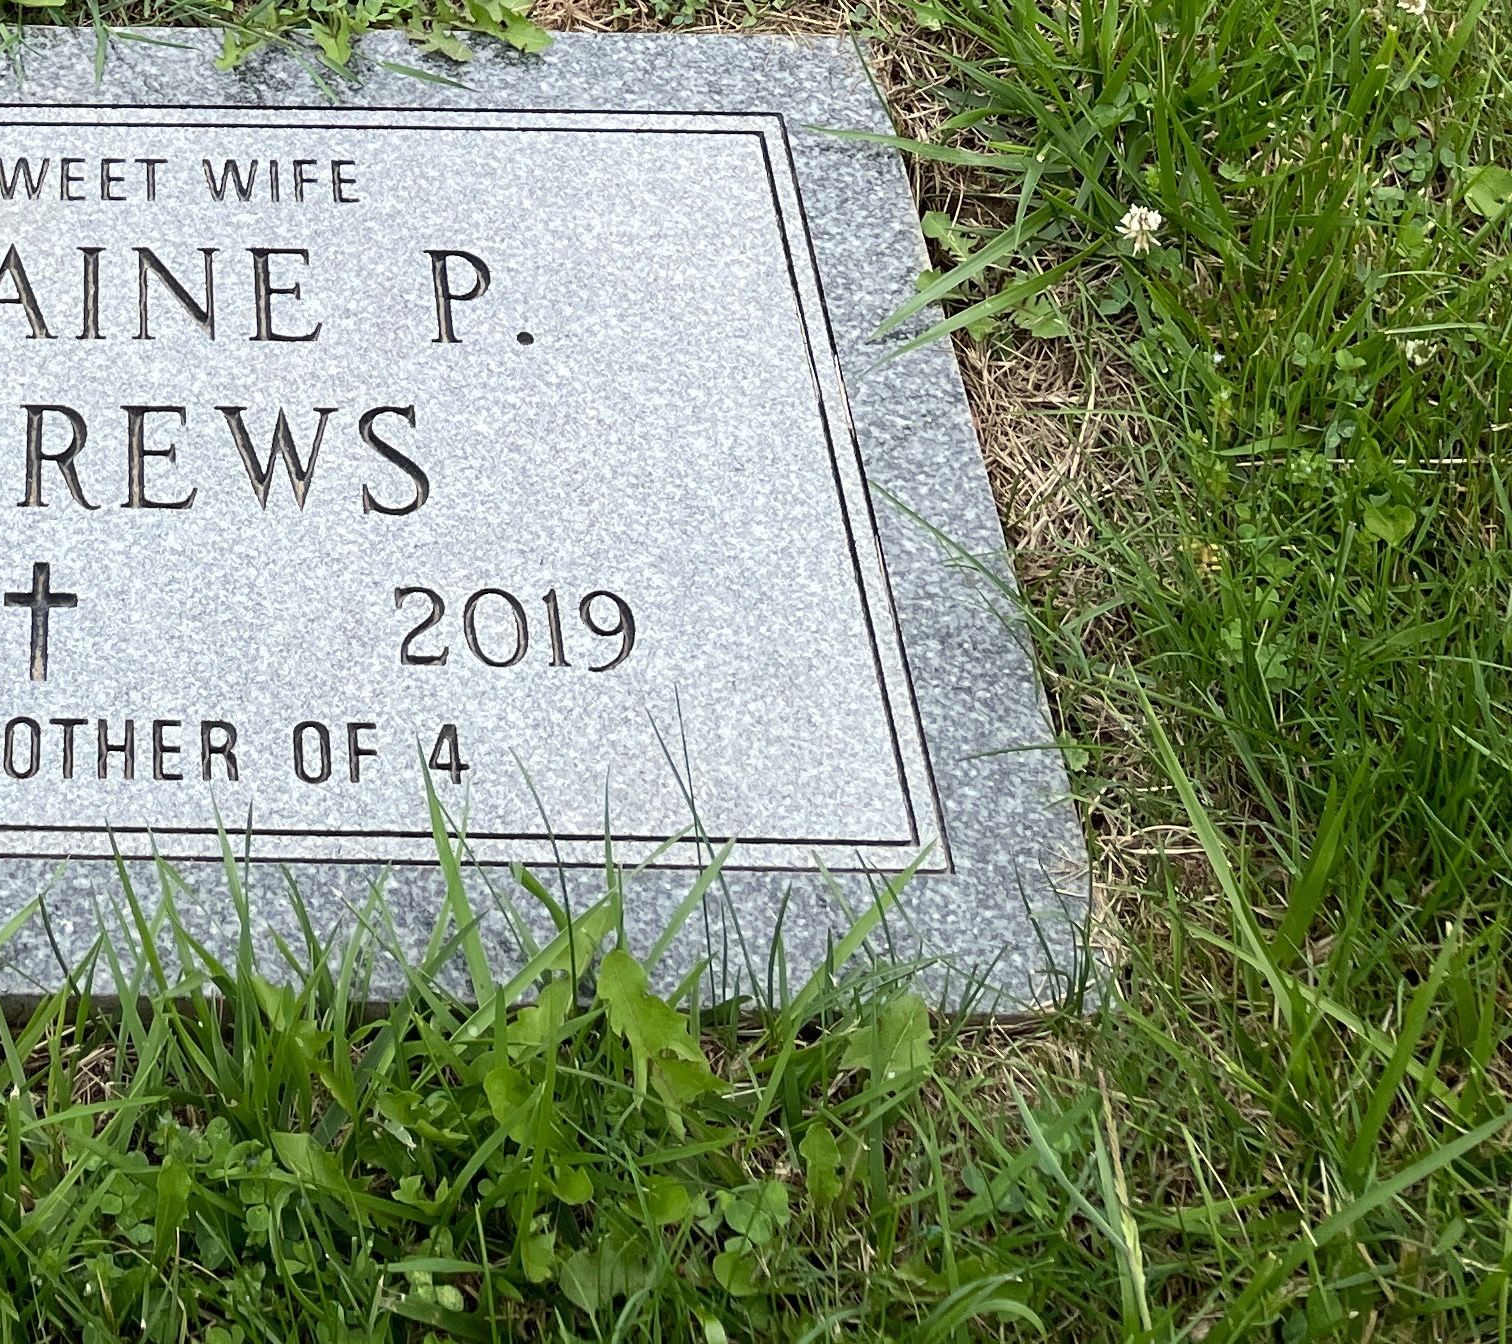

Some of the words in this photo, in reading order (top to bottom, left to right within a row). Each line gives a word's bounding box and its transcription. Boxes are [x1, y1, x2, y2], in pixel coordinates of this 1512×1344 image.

[204, 158, 361, 203] WIFE
[423, 248, 535, 345] P.
[394, 586, 637, 675] 2019
[292, 720, 378, 786] OF
[428, 722, 471, 786] 4
